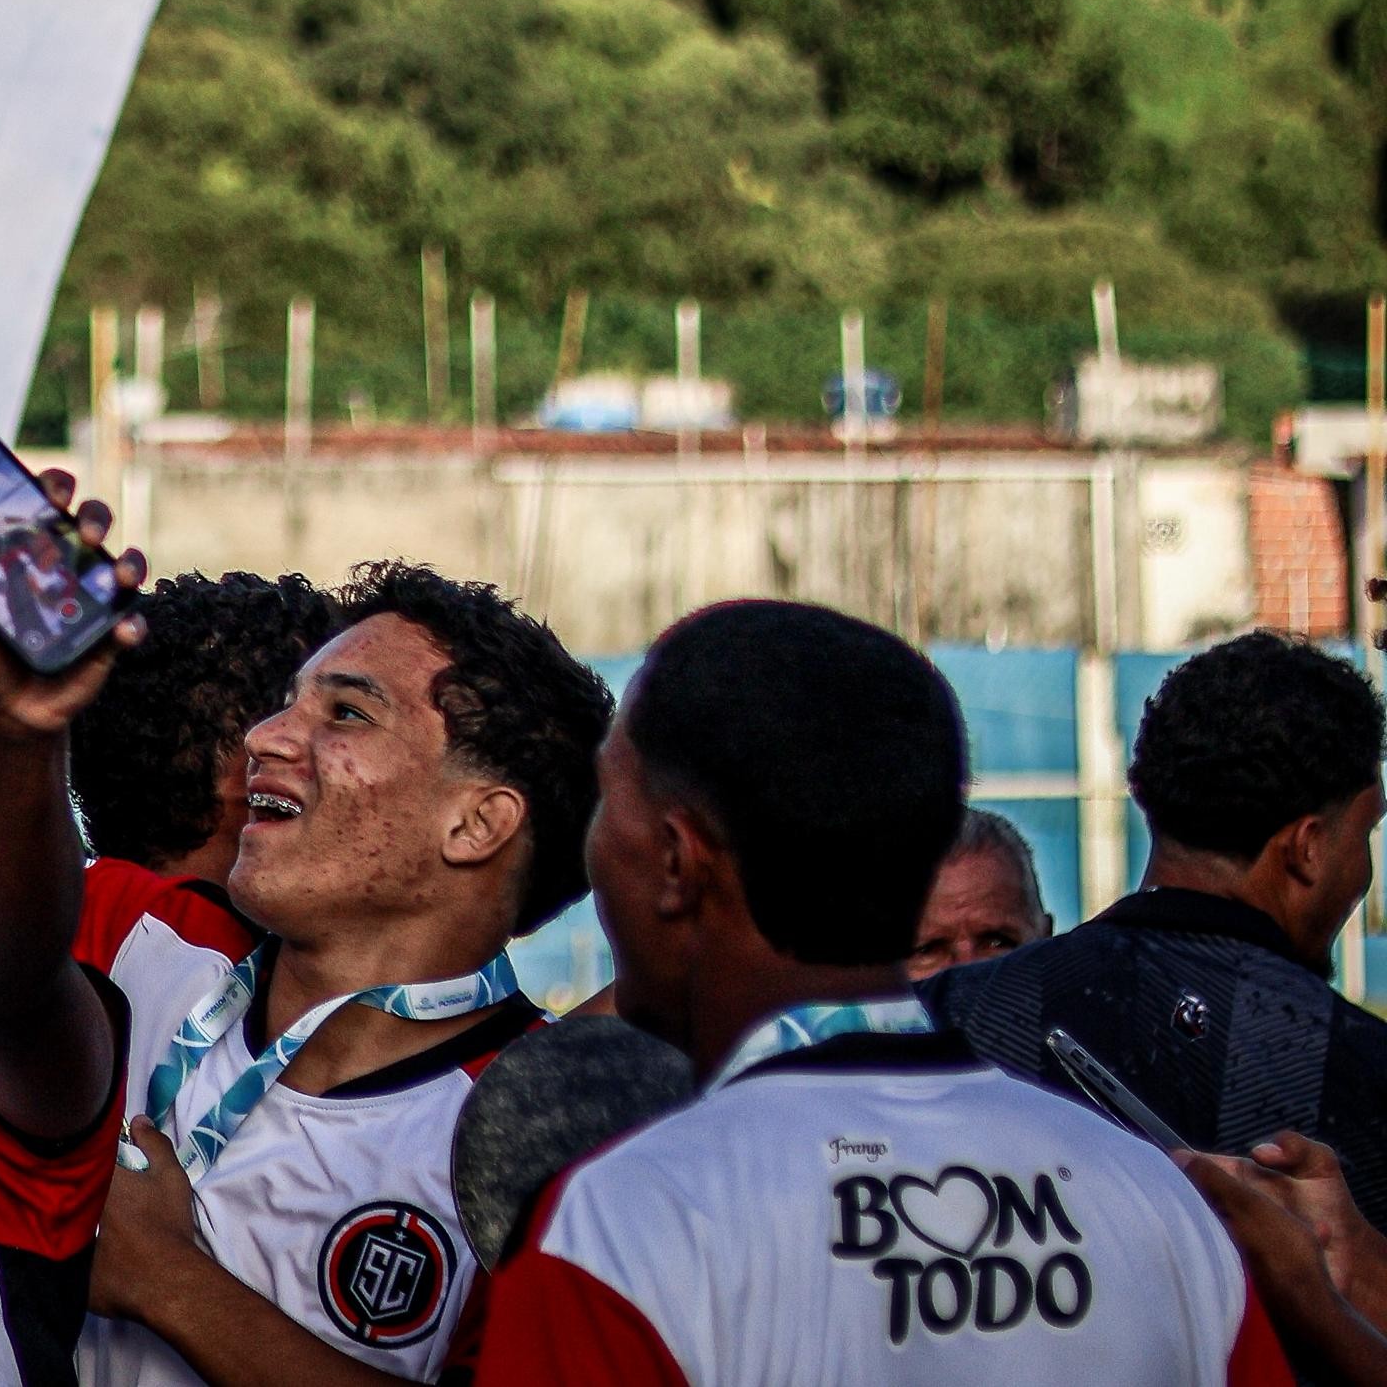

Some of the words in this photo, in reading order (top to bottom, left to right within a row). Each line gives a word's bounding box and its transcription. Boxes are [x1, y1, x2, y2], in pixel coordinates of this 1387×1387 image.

[829, 1136, 887, 1164] Frango
[358, 1243, 417, 1310] SC
[873, 1252, 1094, 1346] TODO
